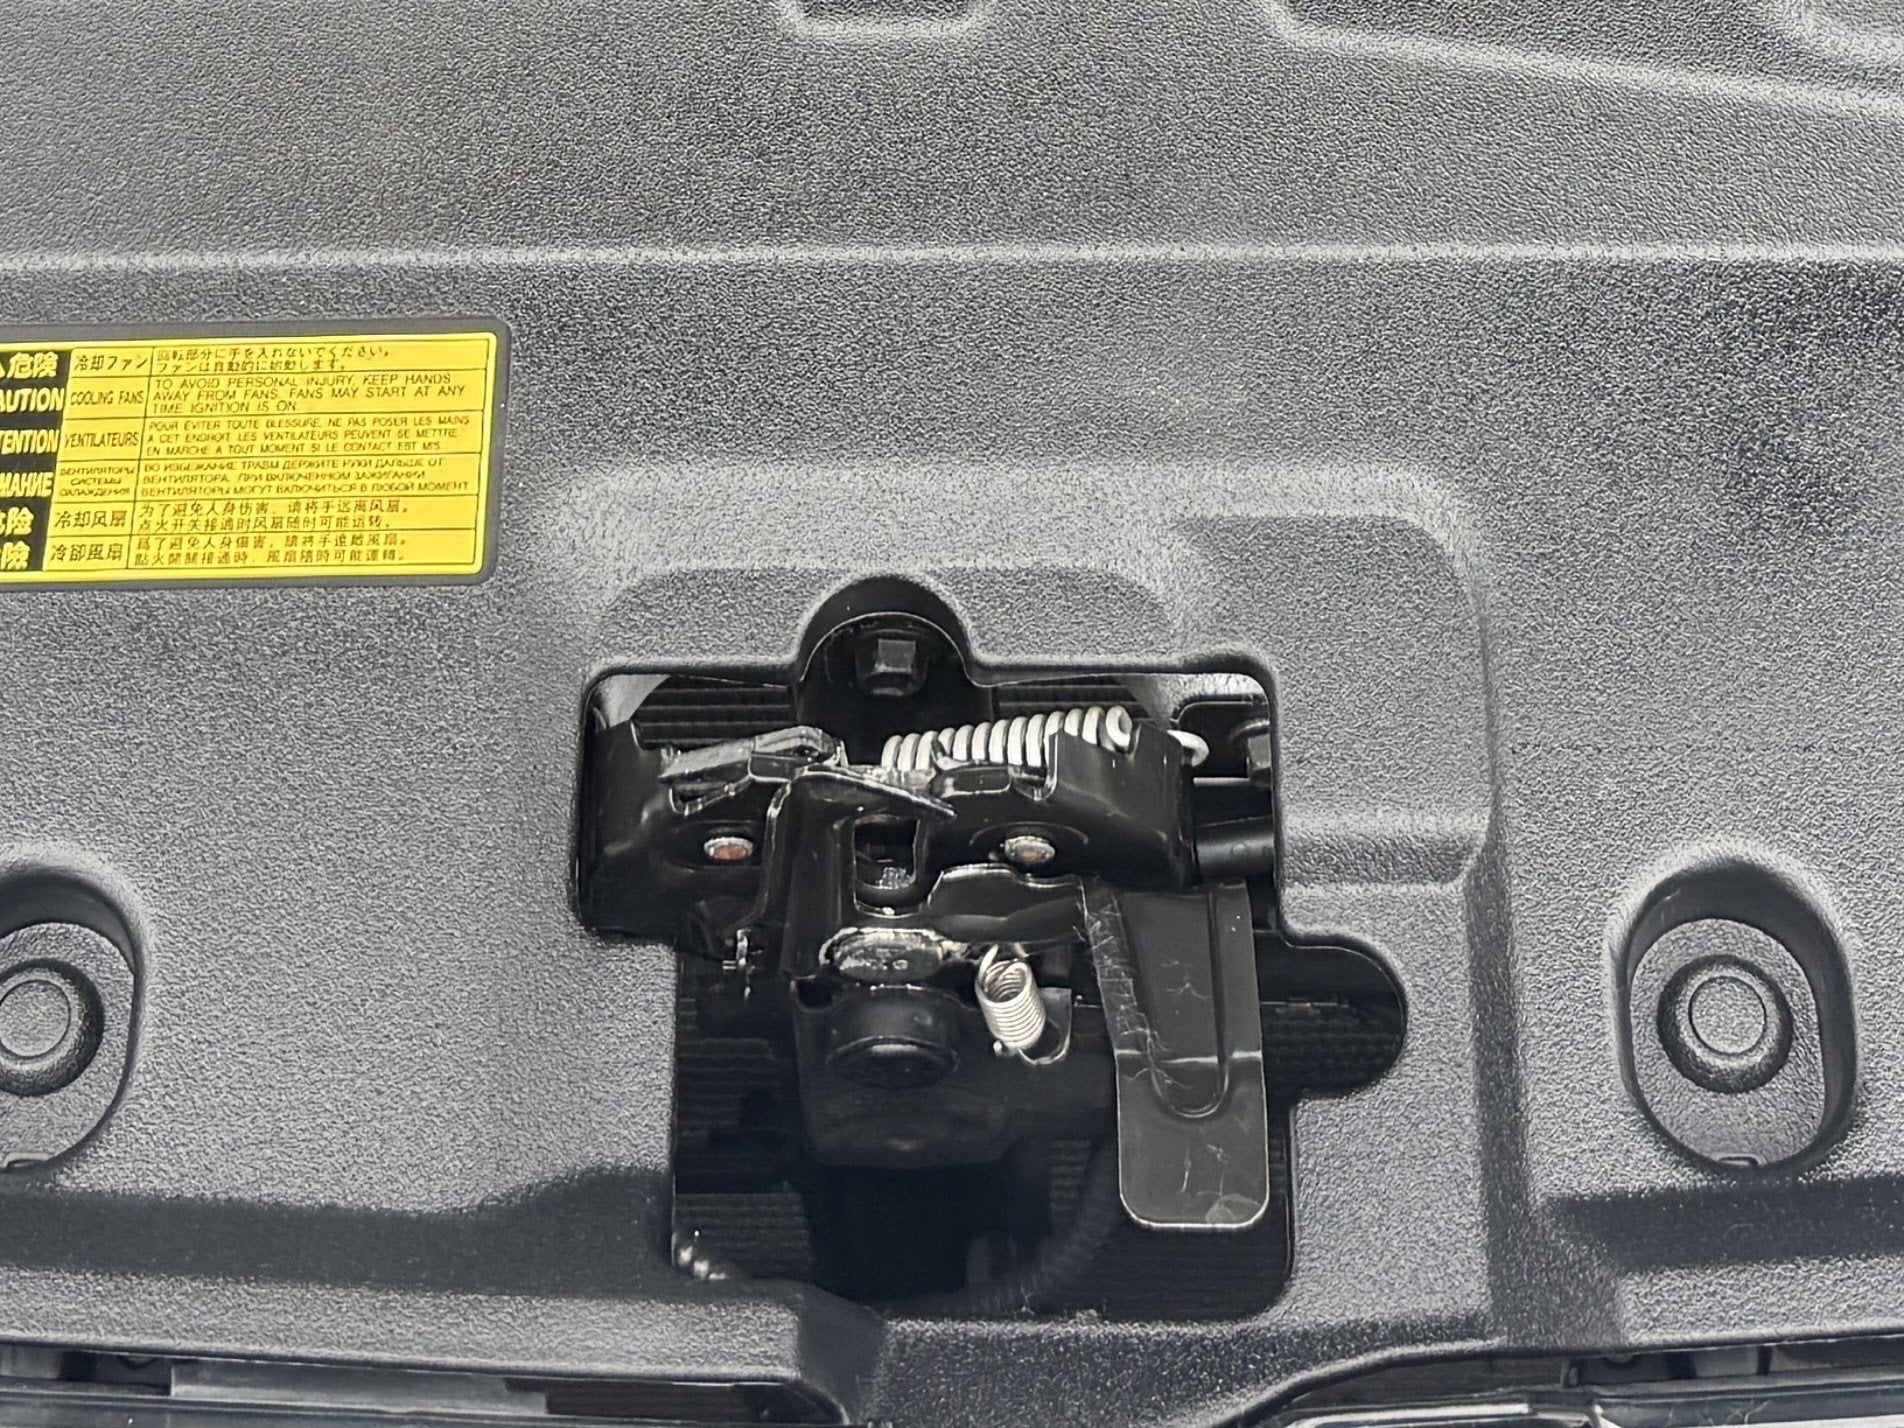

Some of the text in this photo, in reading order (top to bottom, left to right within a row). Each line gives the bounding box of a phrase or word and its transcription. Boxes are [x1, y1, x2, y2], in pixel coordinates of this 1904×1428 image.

[6, 350, 59, 380] 危険
[73, 354, 148, 371] 冷却ファン
[155, 378, 174, 390] TO
[180, 377, 221, 389] AVOID
[227, 376, 298, 388] PERSONAL
[362, 373, 398, 386] KEEP
[404, 372, 452, 385] HANDS
[70, 390, 144, 406] COOLING FANS
[153, 390, 191, 402] AWAY
[196, 389, 237, 401] FROM
[289, 387, 324, 399] FANS
[330, 387, 359, 399] MAY
[364, 386, 407, 398] START
[413, 385, 432, 397] AT
[437, 384, 466, 396] ANY
[152, 402, 184, 414] TIME
[190, 401, 250, 413] IGNITION
[257, 400, 270, 412] IS
[64, 431, 140, 449] VENTILATEURS
[53, 510, 128, 528] 冷却风扇
